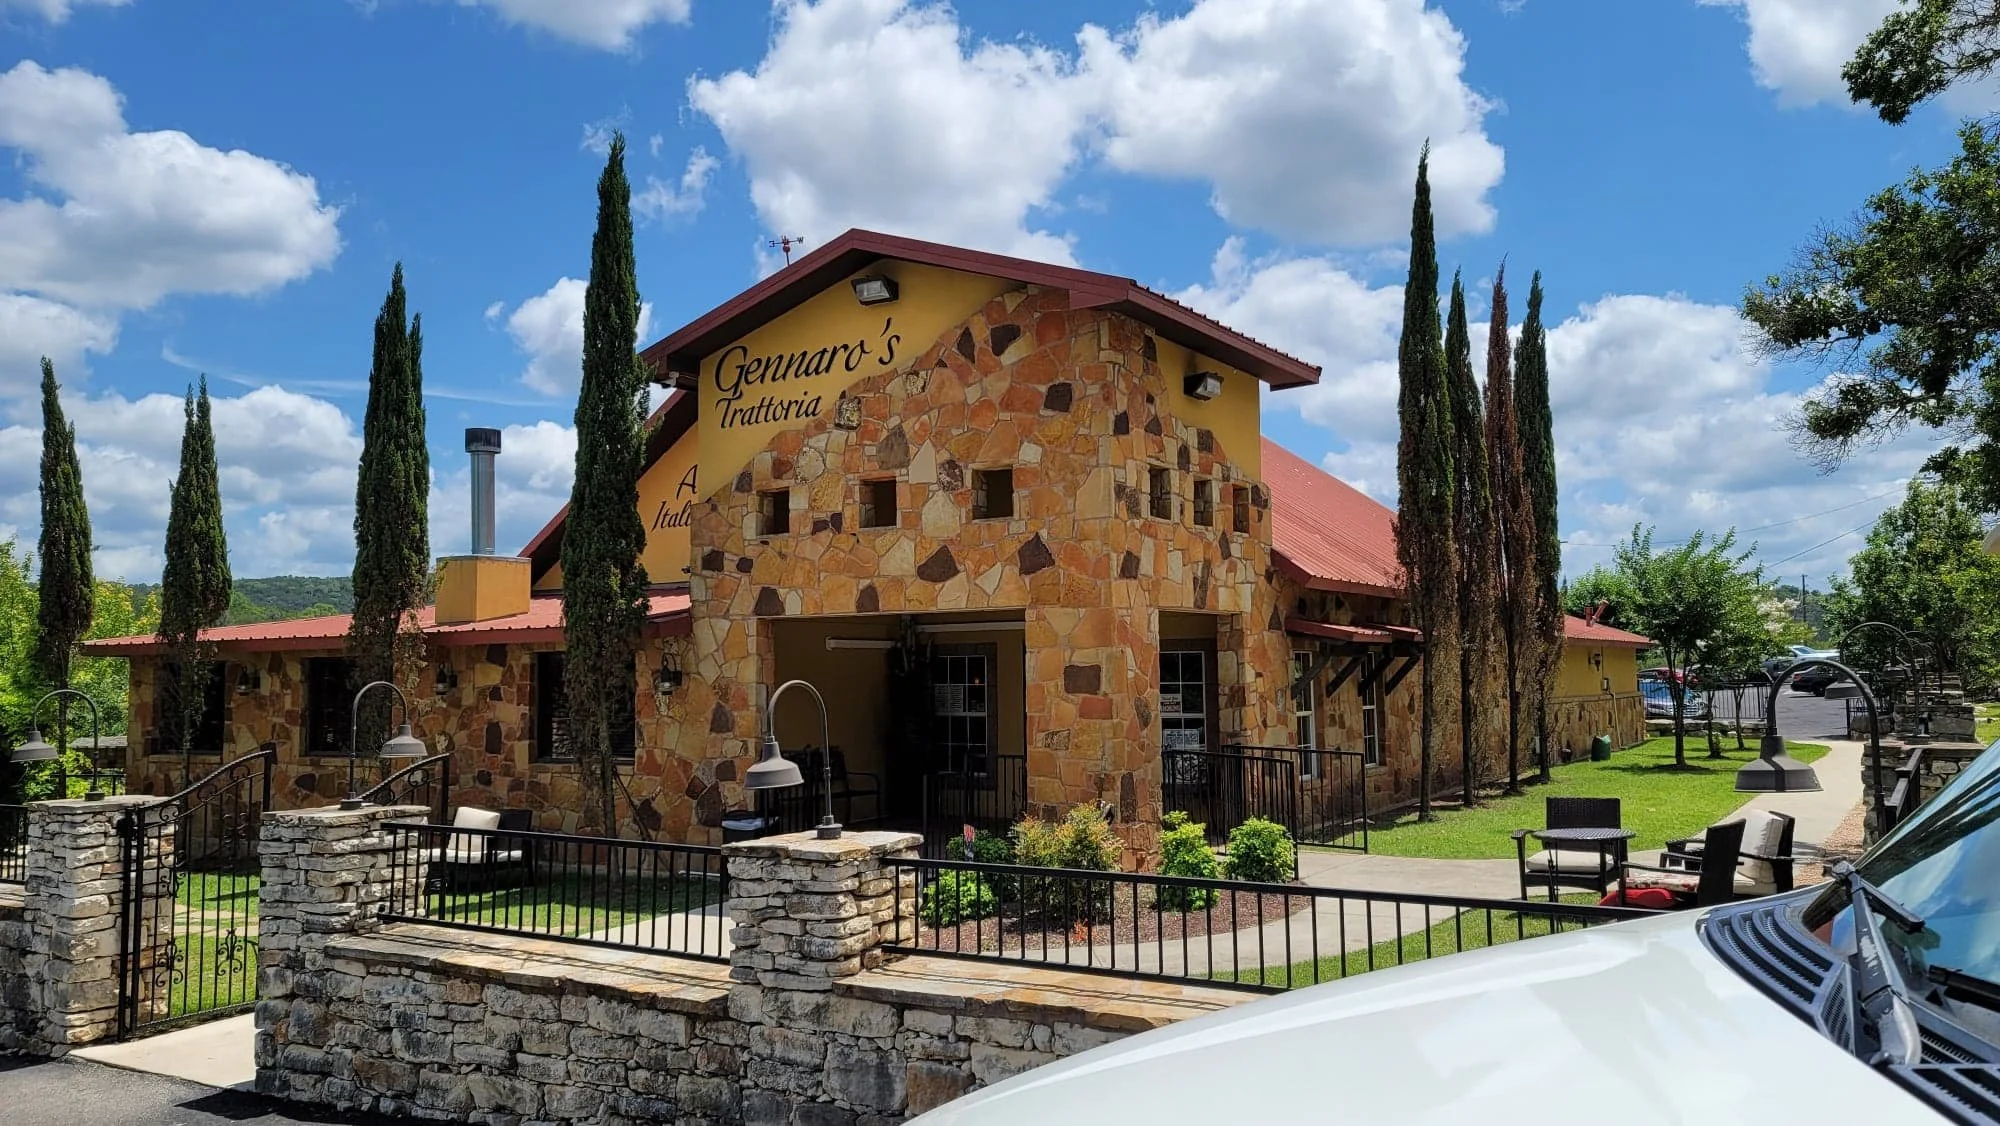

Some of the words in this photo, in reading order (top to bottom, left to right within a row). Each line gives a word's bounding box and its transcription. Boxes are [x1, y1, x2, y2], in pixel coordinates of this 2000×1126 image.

[714, 317, 901, 400] Gennaro's
[715, 391, 822, 429] Trattoria
[677, 464, 698, 500] A
